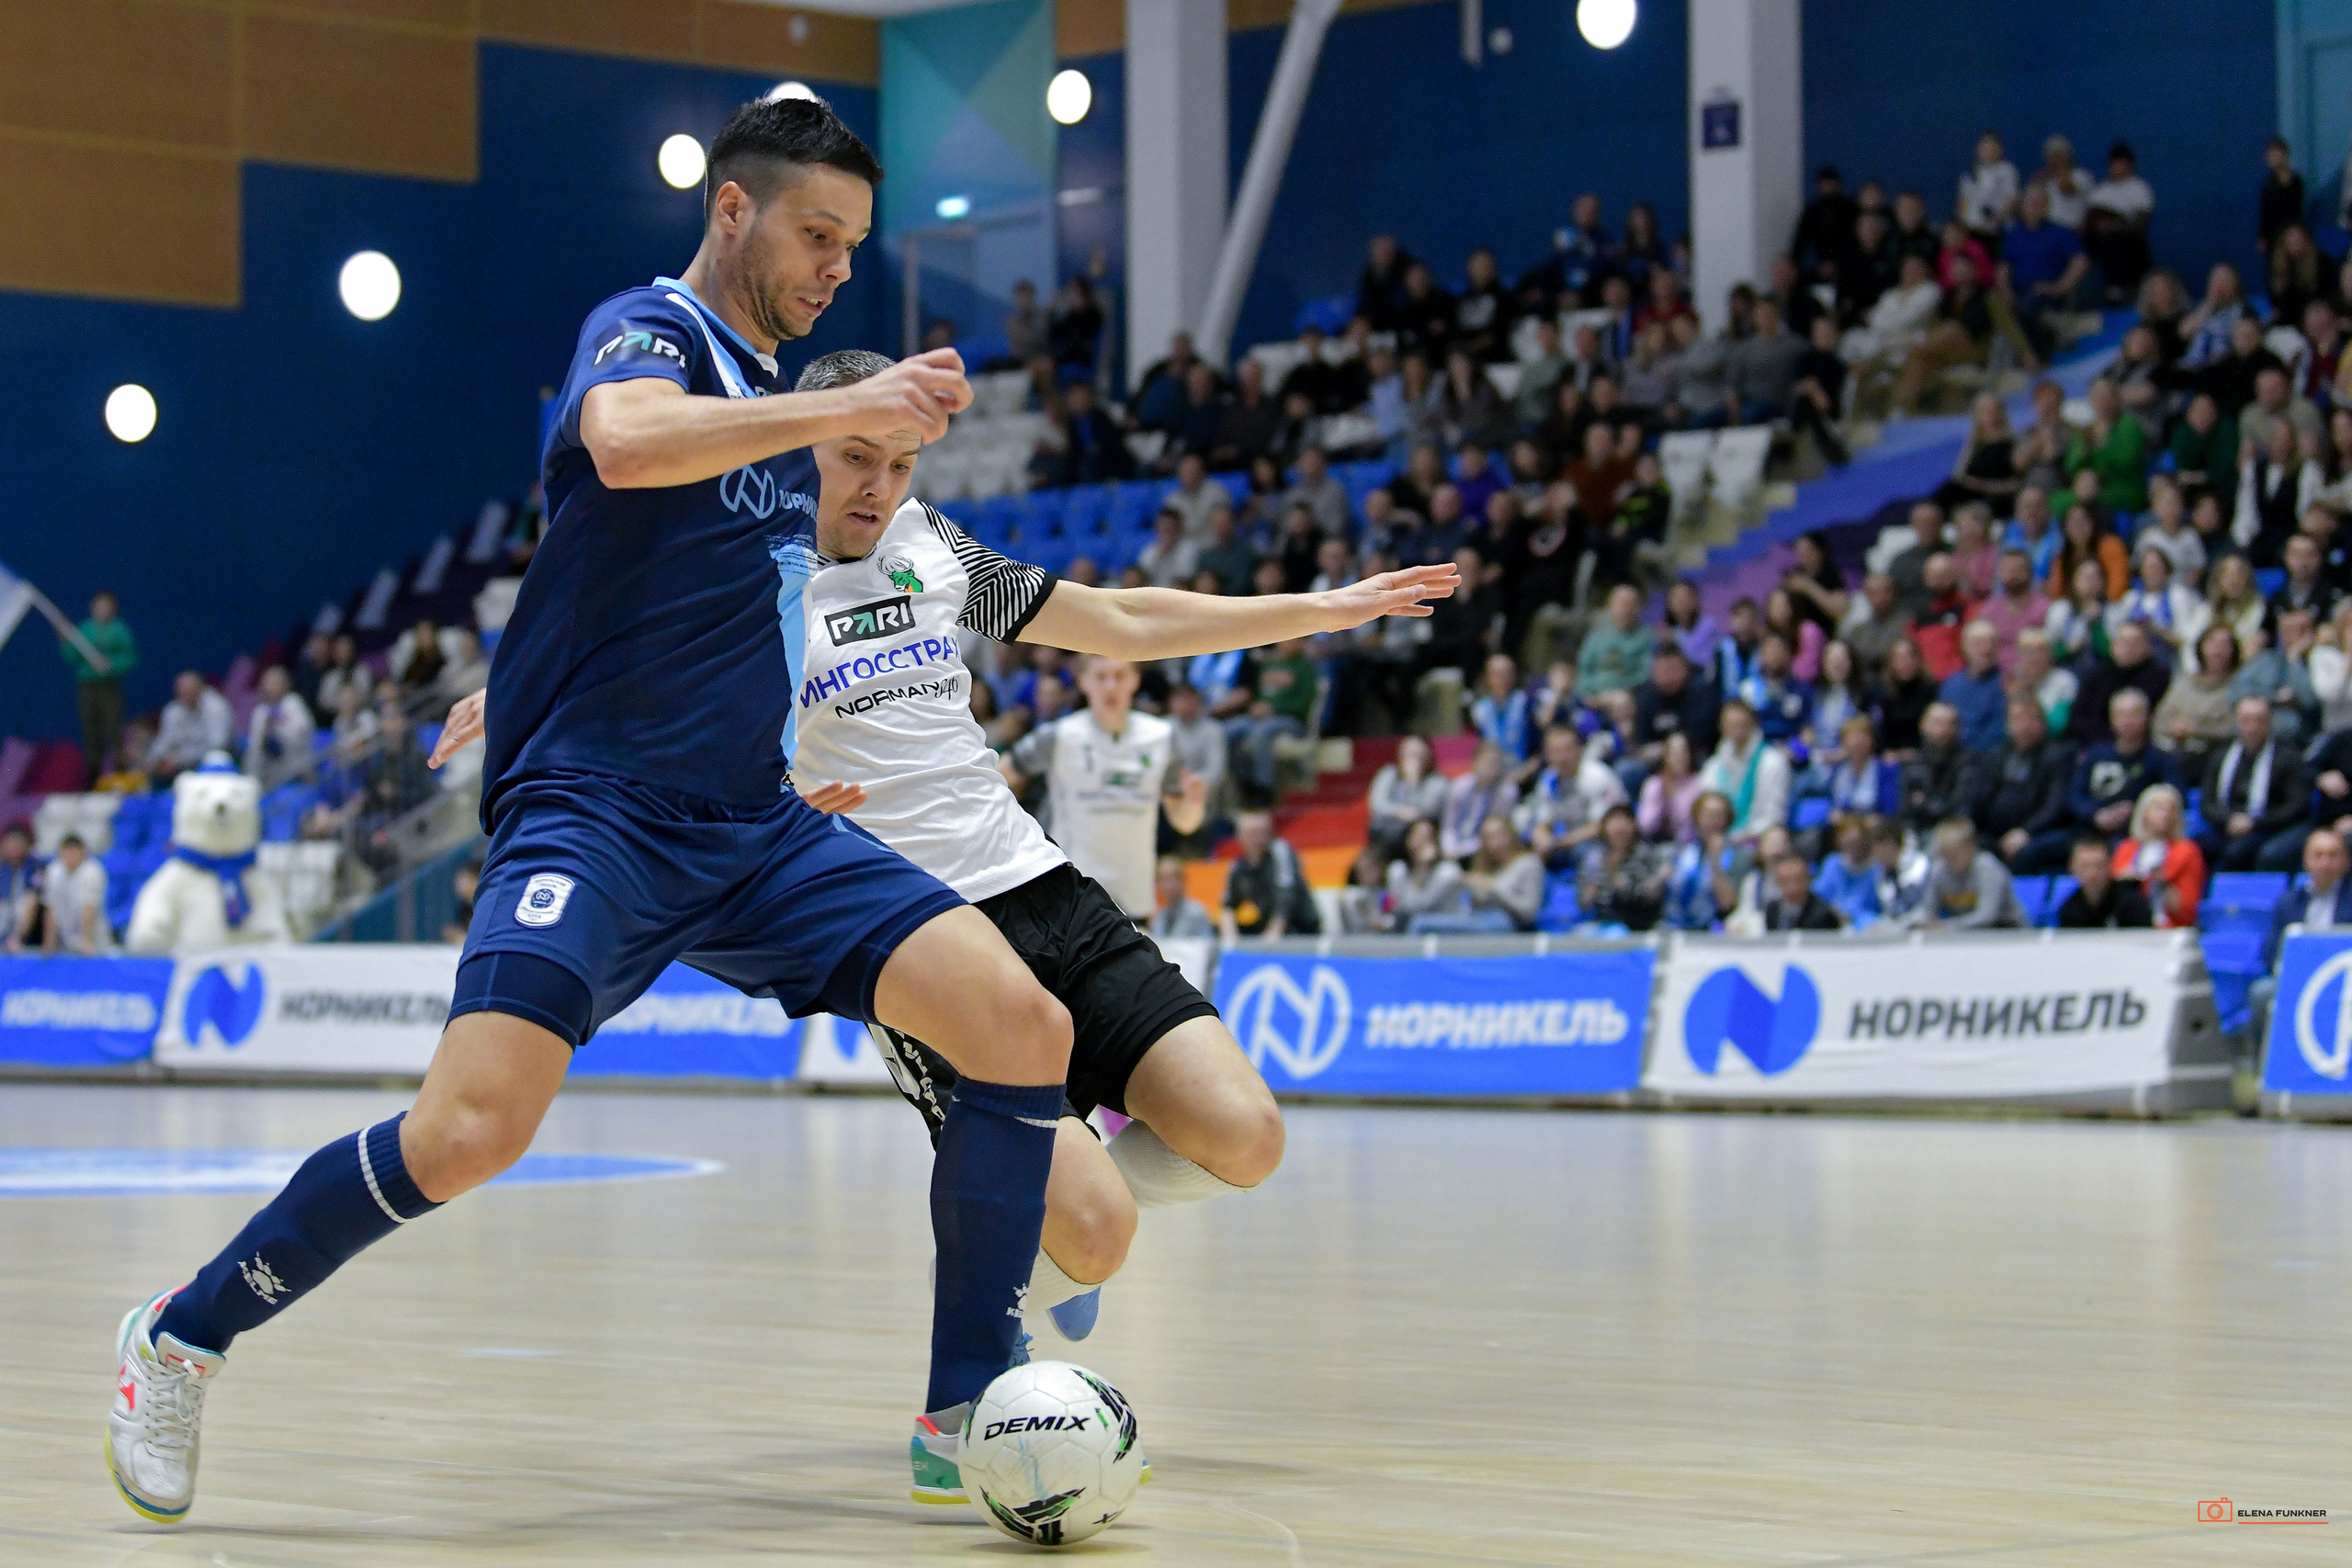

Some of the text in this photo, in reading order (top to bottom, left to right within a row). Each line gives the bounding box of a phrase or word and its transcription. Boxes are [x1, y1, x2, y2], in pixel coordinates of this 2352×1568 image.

[830, 603, 910, 640] PARI
[1365, 999, 1628, 1047] НОРНИКЕЛЬ
[1848, 987, 2148, 1040] НОРНИКЕЛЬ
[984, 1416, 1091, 1440] DEMIX
